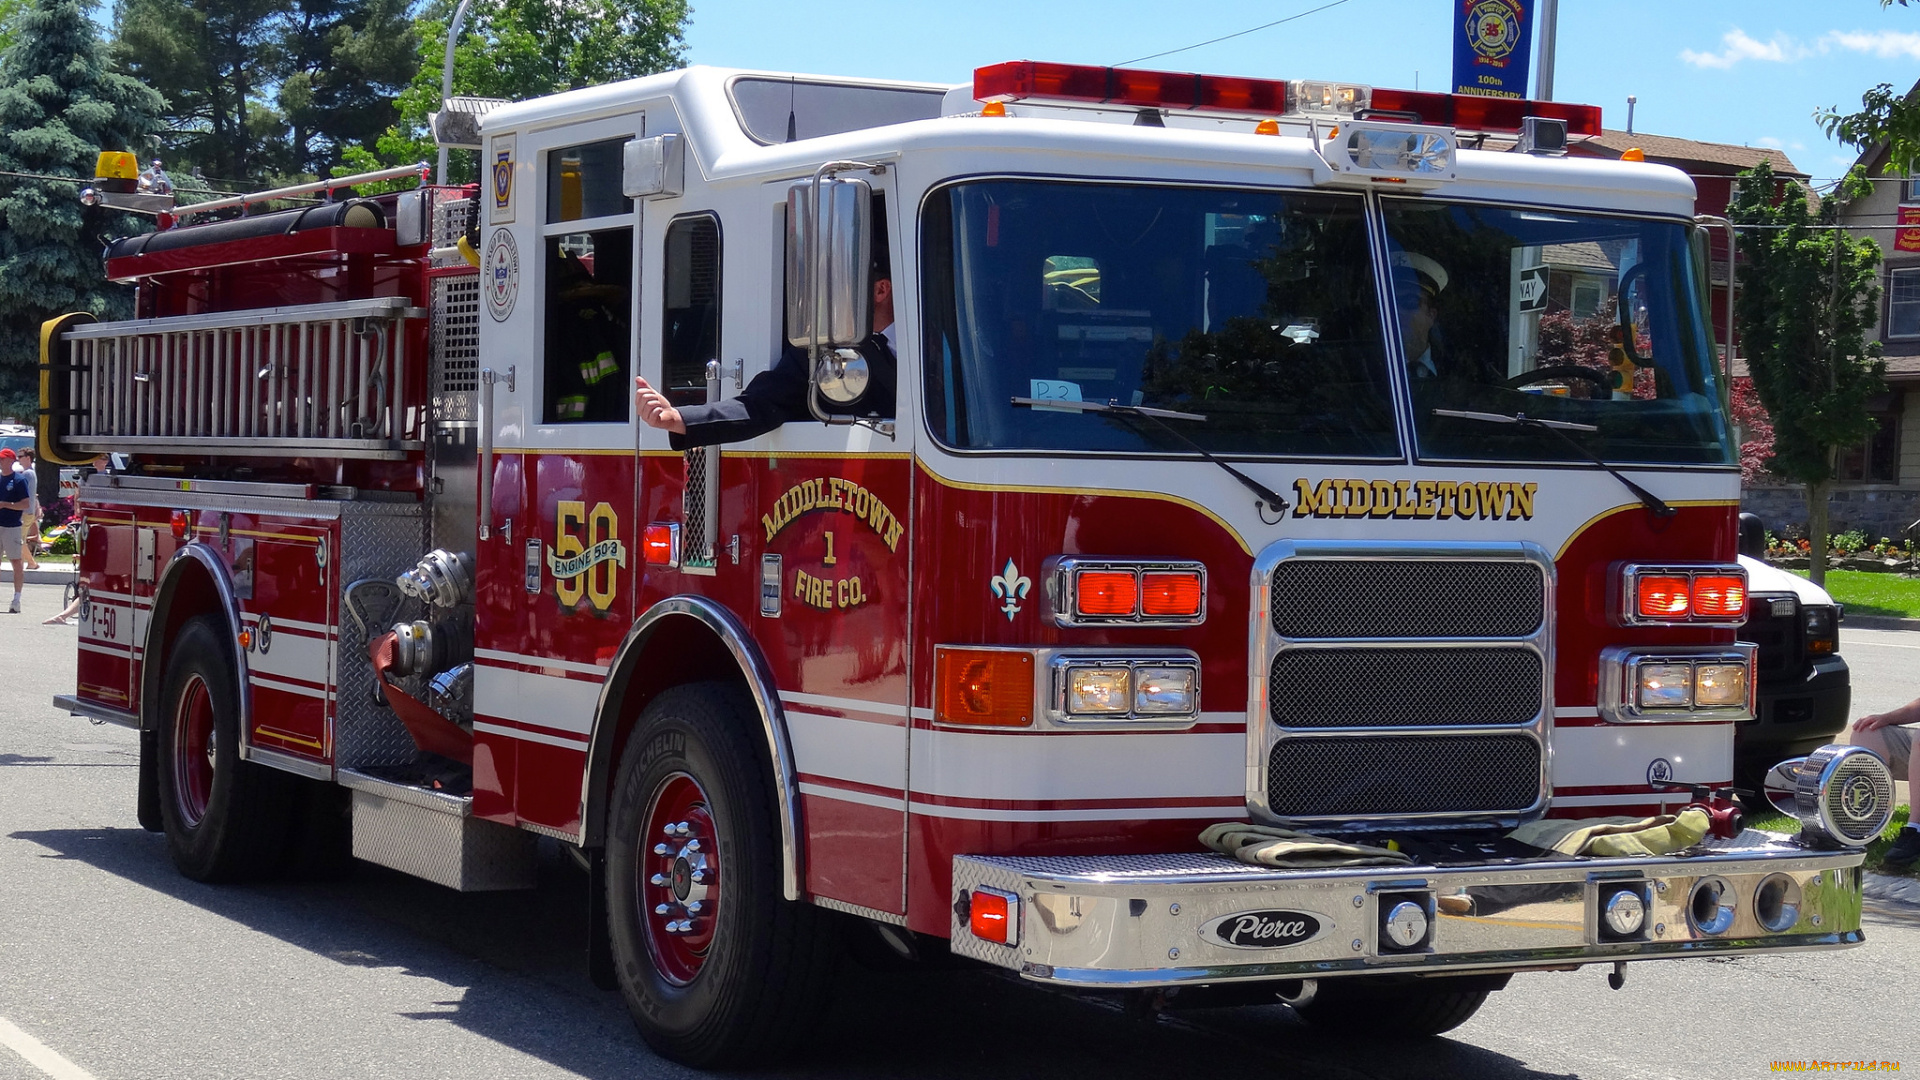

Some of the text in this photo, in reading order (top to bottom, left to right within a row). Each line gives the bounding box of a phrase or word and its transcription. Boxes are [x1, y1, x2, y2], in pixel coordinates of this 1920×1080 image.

[1458, 86, 1521, 98] ANNIVERSARY
[1478, 75, 1503, 86] 100th
[761, 476, 905, 553] MIDDLETOWN
[1292, 478, 1538, 521] MIDDLETOWN
[554, 541, 618, 574] ENGINE 50-3
[555, 500, 619, 611] 50
[823, 531, 836, 564] 1
[794, 568, 867, 608] FIRE CO.
[92, 604, 116, 640] E-50
[626, 731, 685, 804] MICHELIN
[1229, 915, 1306, 944] Pierce
